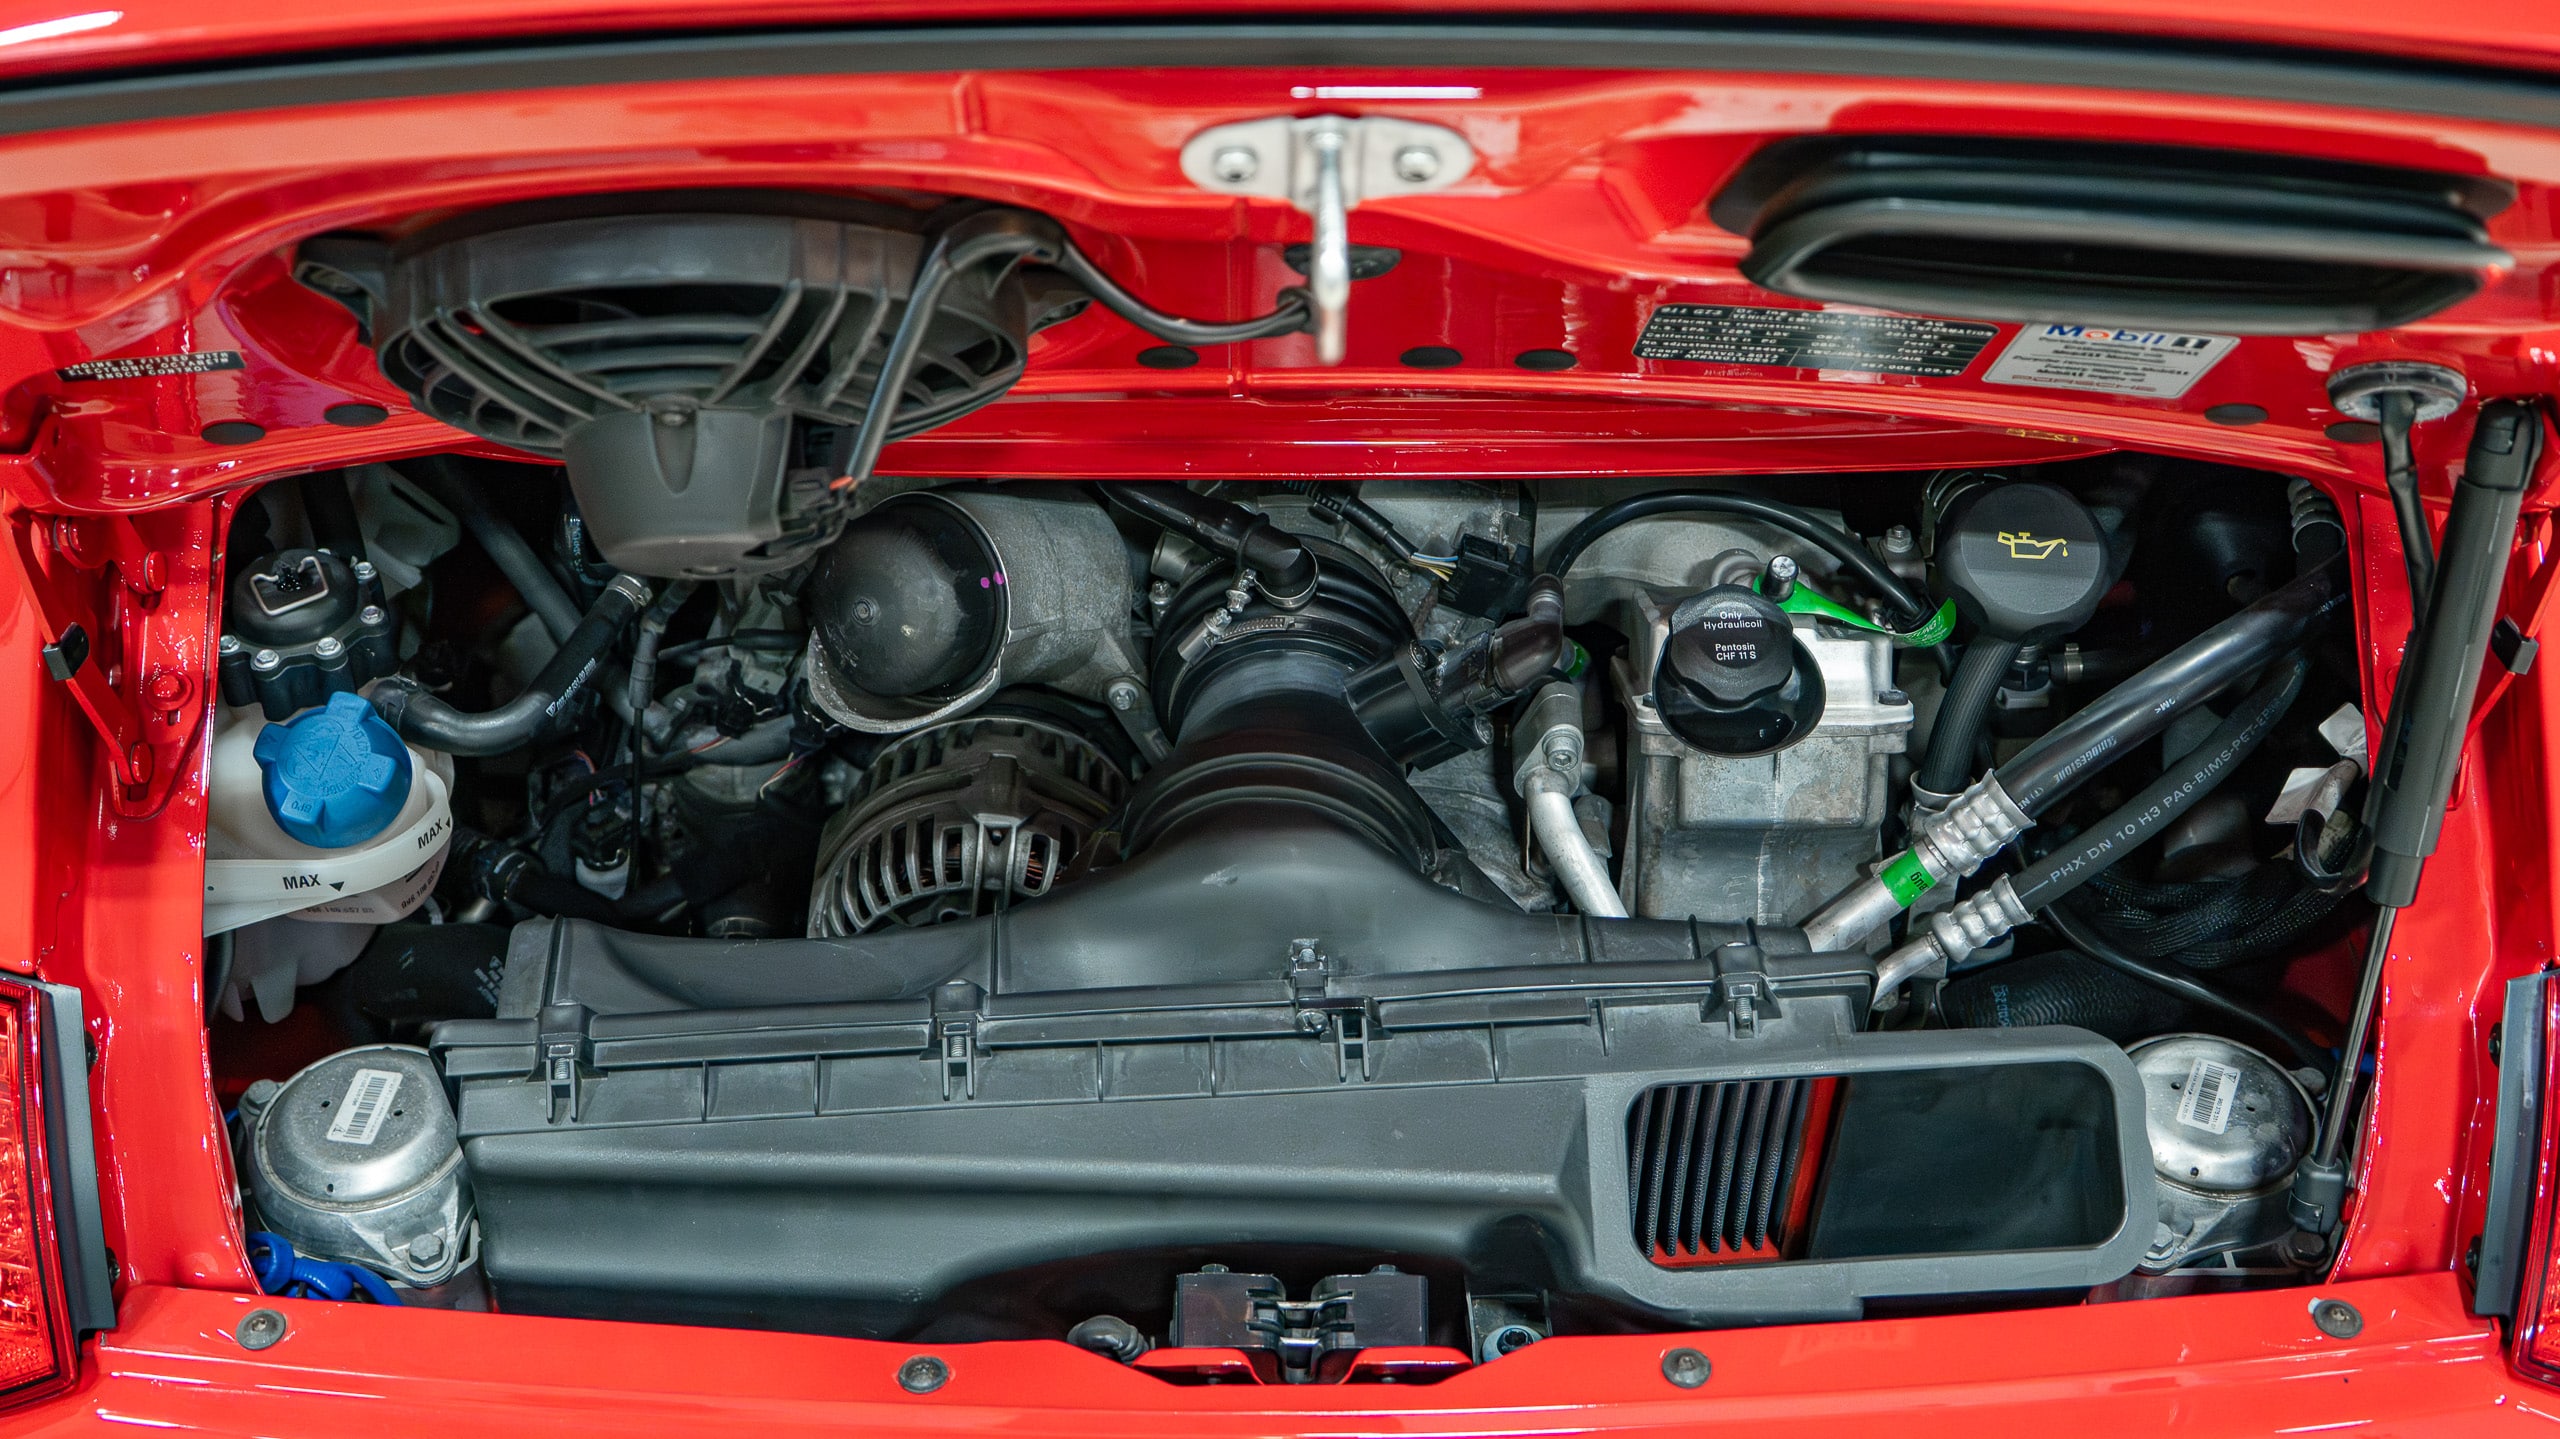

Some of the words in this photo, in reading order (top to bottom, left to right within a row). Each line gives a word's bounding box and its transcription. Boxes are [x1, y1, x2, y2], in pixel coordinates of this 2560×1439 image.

[1692, 308, 1724, 316] GT3
[1654, 317, 1713, 326] Conforms
[1732, 313, 1782, 322] VEHICLE
[1787, 317, 1846, 326] EMISSION
[1852, 320, 1906, 331] CONTROL
[1911, 326, 1995, 337] INFORMATION
[1645, 332, 1711, 342] California:
[2047, 324, 2167, 345] Mobil
[1641, 339, 1658, 347] No
[1662, 341, 1736, 351] adjustments
[120, 359, 134, 367] IS
[140, 354, 189, 366] FITTED
[194, 351, 230, 361] WITH
[68, 364, 155, 376] ELECTRONIC
[96, 371, 142, 381] KNOCK
[149, 366, 211, 376] CONTROL
[2011, 375, 2158, 393] PORSCHE
[1719, 611, 1742, 620] Only
[1703, 620, 1762, 630] Hydraulicoil
[1715, 643, 1755, 651] Pentosin
[1716, 652, 1736, 661] CHF
[1739, 652, 1747, 660] 11
[1749, 651, 1757, 660] S
[2054, 735, 2119, 786] BRIDGESTONE
[416, 818, 444, 849] MAX
[2049, 854, 2088, 885] PHX
[2088, 839, 2116, 862] DN
[2116, 824, 2138, 844] 10
[2139, 804, 2163, 830] H3
[282, 873, 322, 890] MAX
